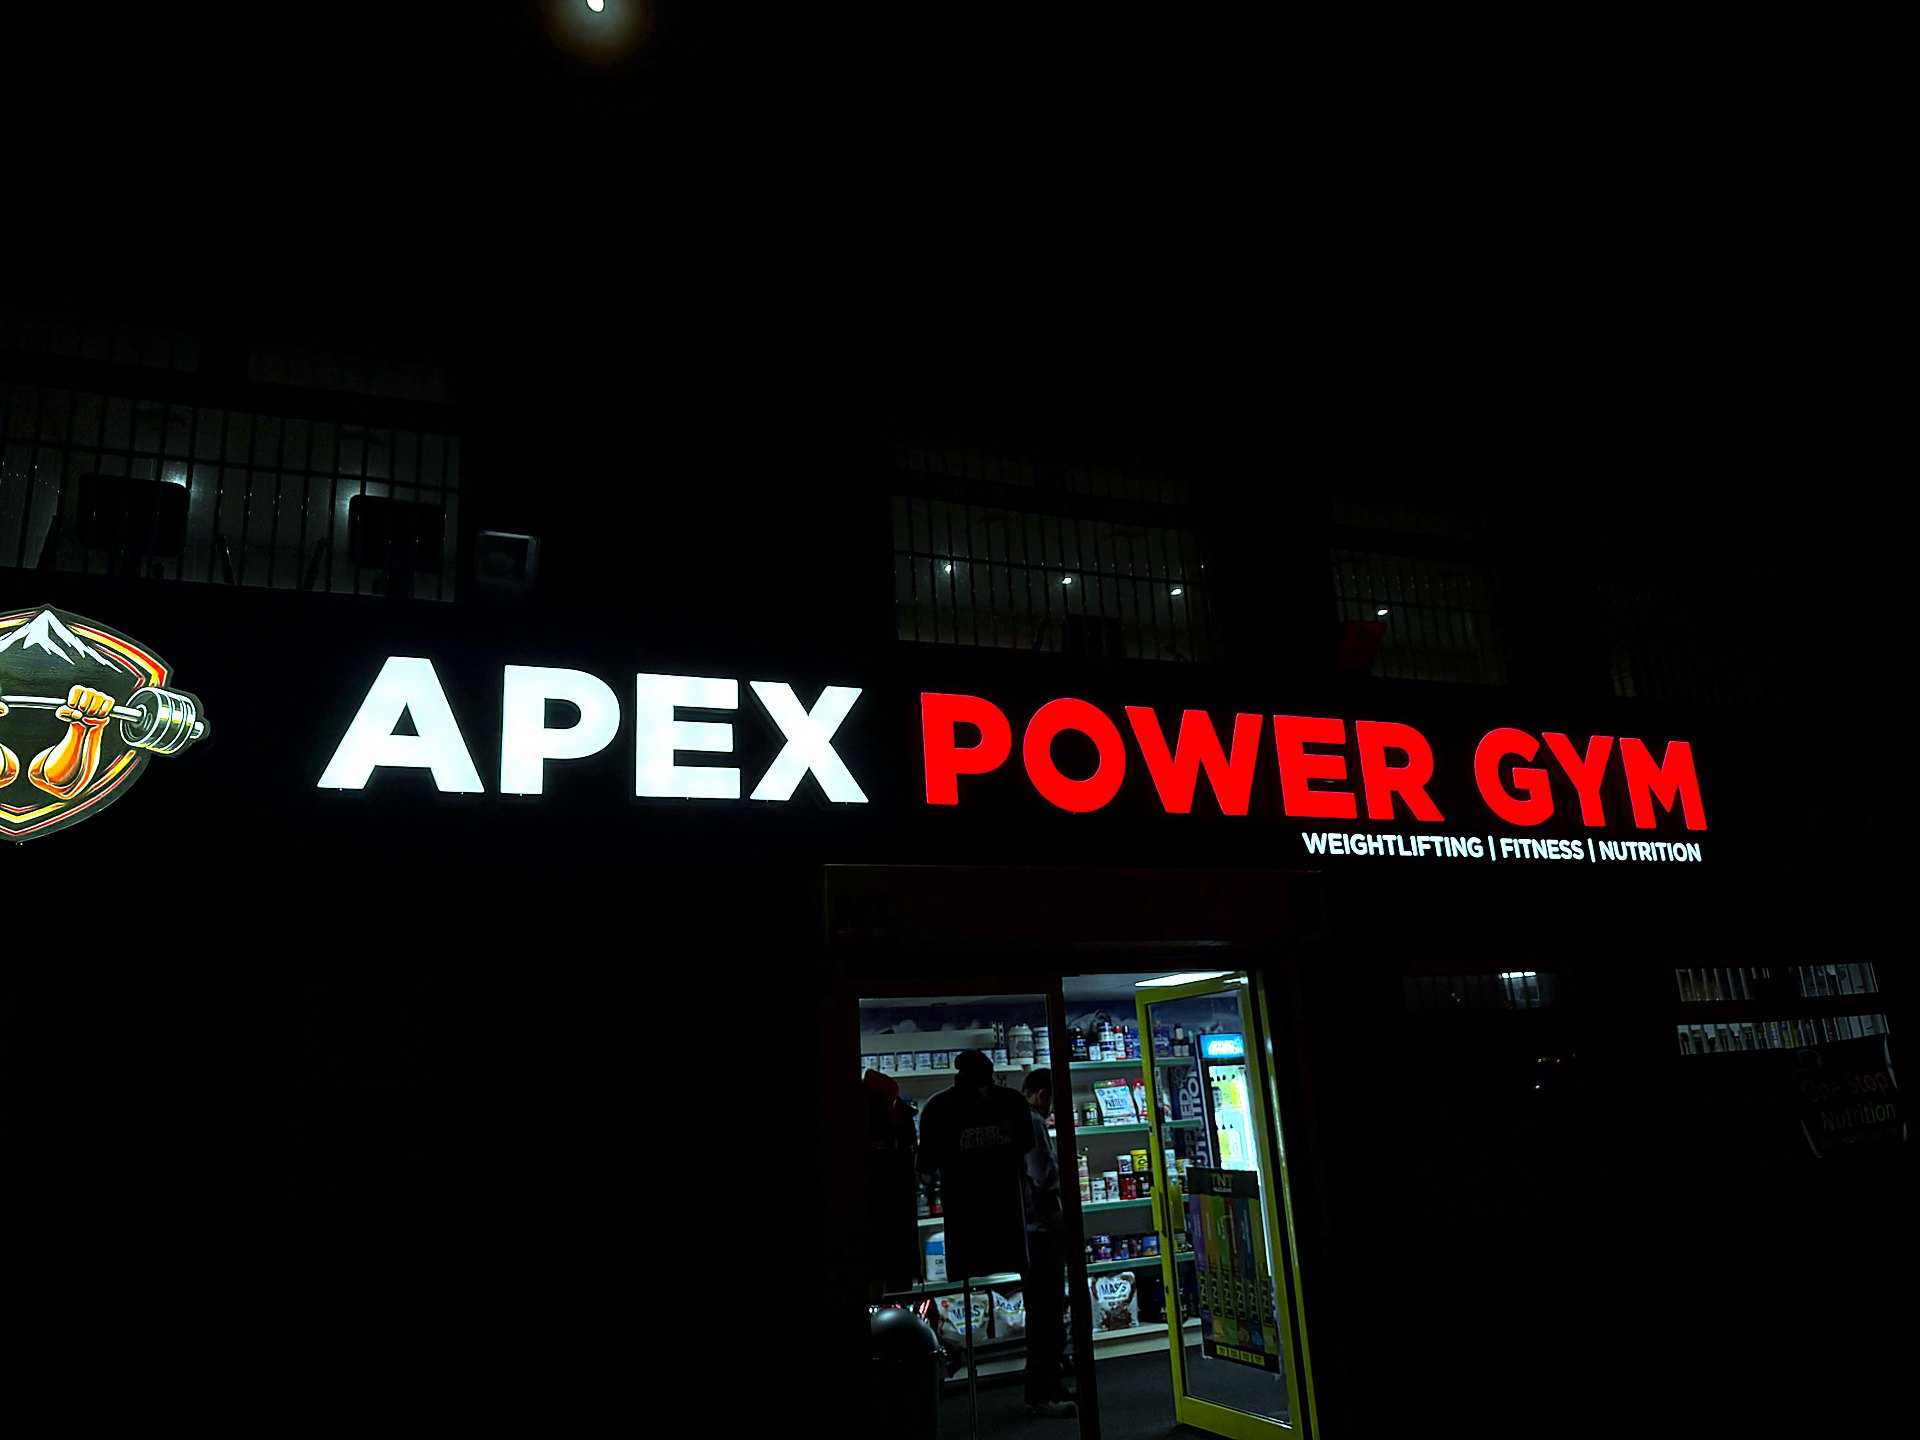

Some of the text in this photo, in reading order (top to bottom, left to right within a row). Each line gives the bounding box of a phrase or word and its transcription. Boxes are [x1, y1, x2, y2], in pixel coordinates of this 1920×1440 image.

[317, 656, 1707, 831] APEX POWER GYM
[1302, 832, 1702, 862] WEIGHTLIFTING FITNESS NUTRITION
[1801, 1072, 1888, 1102] One Stop
[1821, 1102, 1896, 1131] Nutrition
[1211, 1173, 1233, 1187] TNT
[1101, 1282, 1127, 1294] MASS
[952, 1304, 981, 1320] MS
